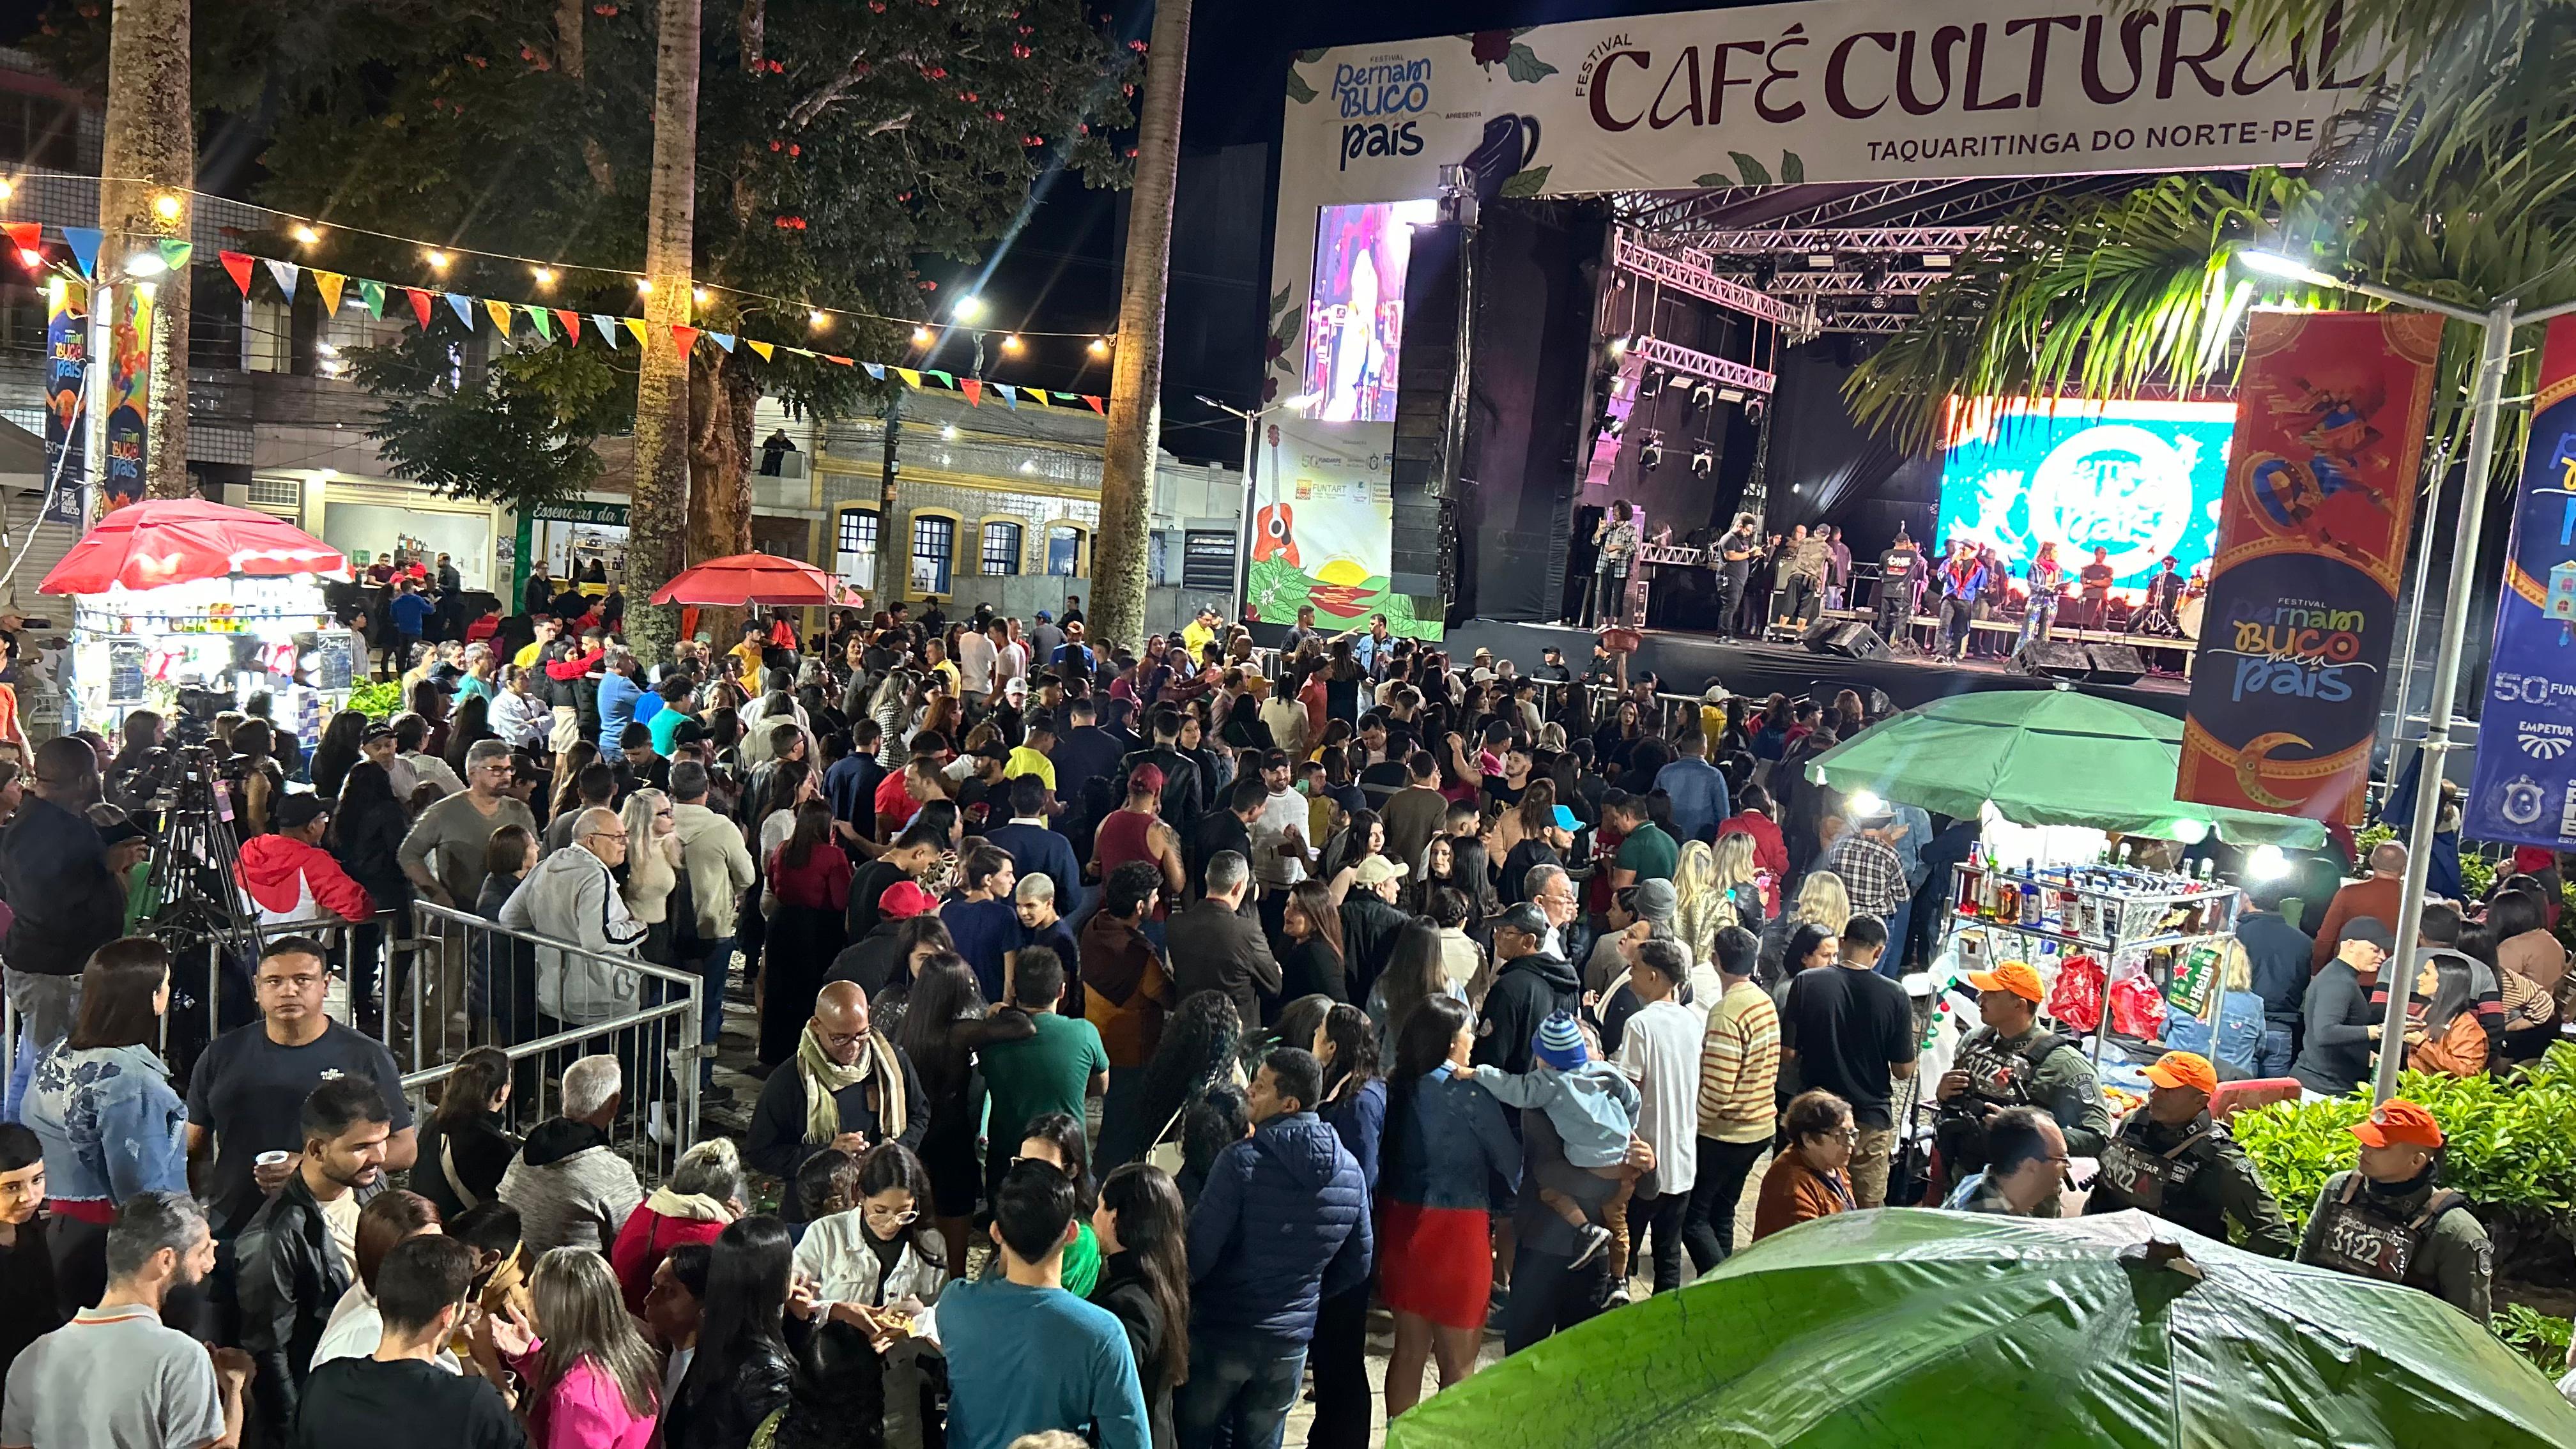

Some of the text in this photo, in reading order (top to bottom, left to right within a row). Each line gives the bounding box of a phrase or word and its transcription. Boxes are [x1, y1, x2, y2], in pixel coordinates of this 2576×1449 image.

[1370, 54, 1404, 63] FESTIVAL
[1575, 33, 1632, 97] FESTIVAL
[1590, 0, 2387, 132] CAFÉ CULTURAL
[1339, 82, 1429, 119] BUCO
[1445, 111, 1482, 120] APRESENTA
[1867, 119, 2315, 162] TAQUARITINGA DO NORTE-PE
[1312, 484, 1346, 493] FUNTART
[533, 501, 592, 521] Essencas
[597, 506, 617, 522] da
[2278, 597, 2327, 609] FESTIVAL
[2232, 620, 2359, 661] BUCO
[2232, 657, 2352, 702] país
[2494, 671, 2549, 703] 50
[2518, 721, 2574, 736] EMPETUR
[2128, 1157, 2159, 1175] MILITAR
[2331, 1226, 2382, 1267] 3122
